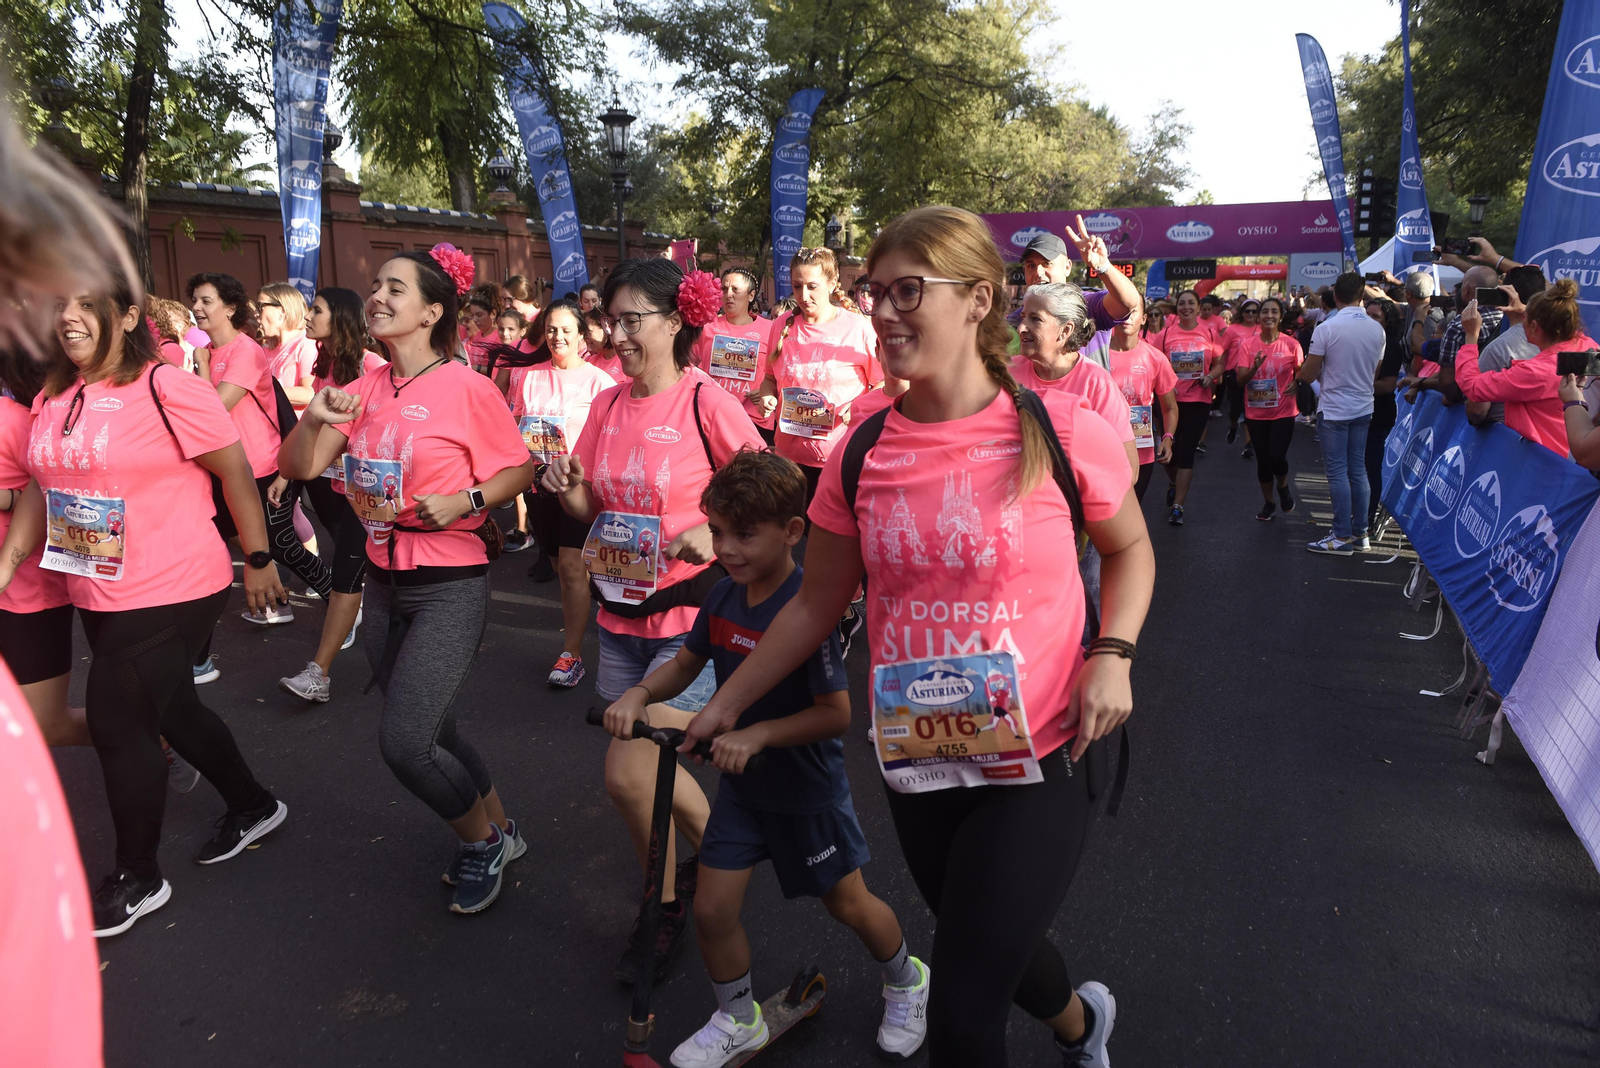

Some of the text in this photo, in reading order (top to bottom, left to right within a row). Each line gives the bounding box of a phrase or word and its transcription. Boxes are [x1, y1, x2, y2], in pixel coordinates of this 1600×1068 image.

[1170, 229, 1211, 239] ASTURIANA
[1238, 226, 1277, 236] OYSHO
[1301, 224, 1340, 234] Santander
[1173, 266, 1209, 274] OYSHO
[1302, 267, 1339, 276] ASTURIANA
[725, 352, 744, 362] 016
[796, 406, 818, 418] 016
[532, 435, 552, 444] 016
[647, 430, 678, 440] ASTURIANA
[355, 490, 377, 509] 016
[65, 508, 98, 521] ASTURIANA
[1457, 491, 1492, 548] ASTURIANA
[67, 525, 99, 545] 016
[601, 528, 631, 540] ASTURIANA
[599, 546, 630, 565] 016
[50, 557, 78, 569] OYSHO
[878, 596, 1023, 624] TU DORSAL
[881, 621, 1025, 665] SUMA
[910, 685, 970, 700] ASTURIANA
[914, 711, 977, 740] 016
[935, 742, 968, 756] 4755
[911, 757, 946, 767] CARRERA
[971, 754, 1000, 763] MUJER
[899, 771, 946, 787] OYSHO
[806, 844, 837, 866] Joma
